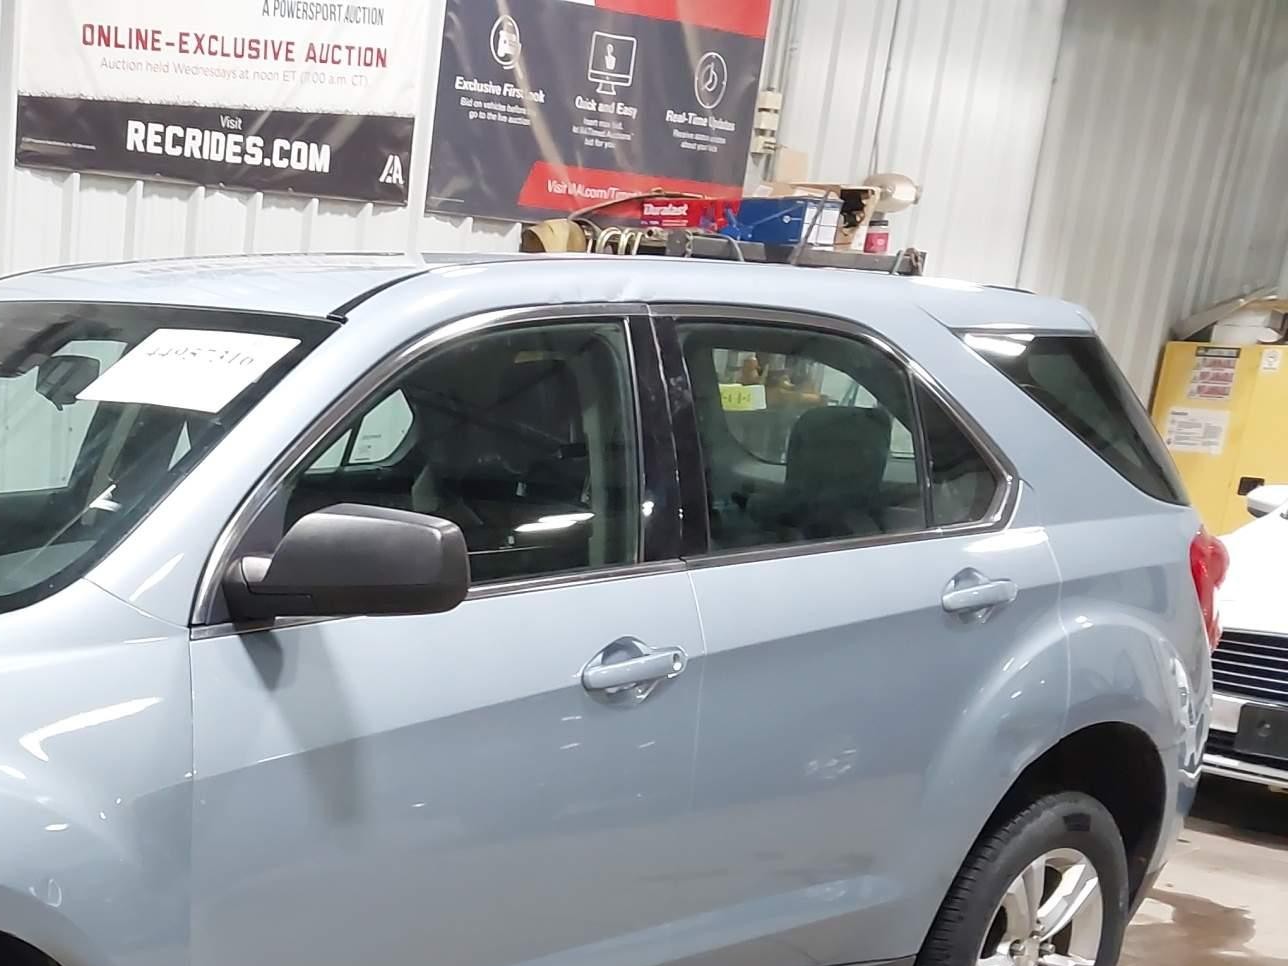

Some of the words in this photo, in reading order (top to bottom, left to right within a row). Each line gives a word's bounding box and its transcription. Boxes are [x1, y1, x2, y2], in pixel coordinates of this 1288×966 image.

[262, 0, 270, 17] A
[273, 0, 343, 22] POWERSPORT
[344, 4, 385, 26] AUCTION
[82, 23, 295, 63] ONLINE-EXCLUSIVE
[304, 42, 387, 68] AUCTION
[100, 56, 143, 72] Auction
[146, 60, 169, 74] held
[172, 62, 238, 80] Wednesdays
[455, 76, 502, 95] Exclusive
[503, 83, 525, 99] Firs
[575, 95, 597, 112] Quick
[598, 102, 616, 114] and
[616, 102, 638, 120] Easy
[665, 109, 708, 127] Real-Time
[219, 115, 242, 131] Visit
[126, 119, 331, 174] RECRIDES.COM
